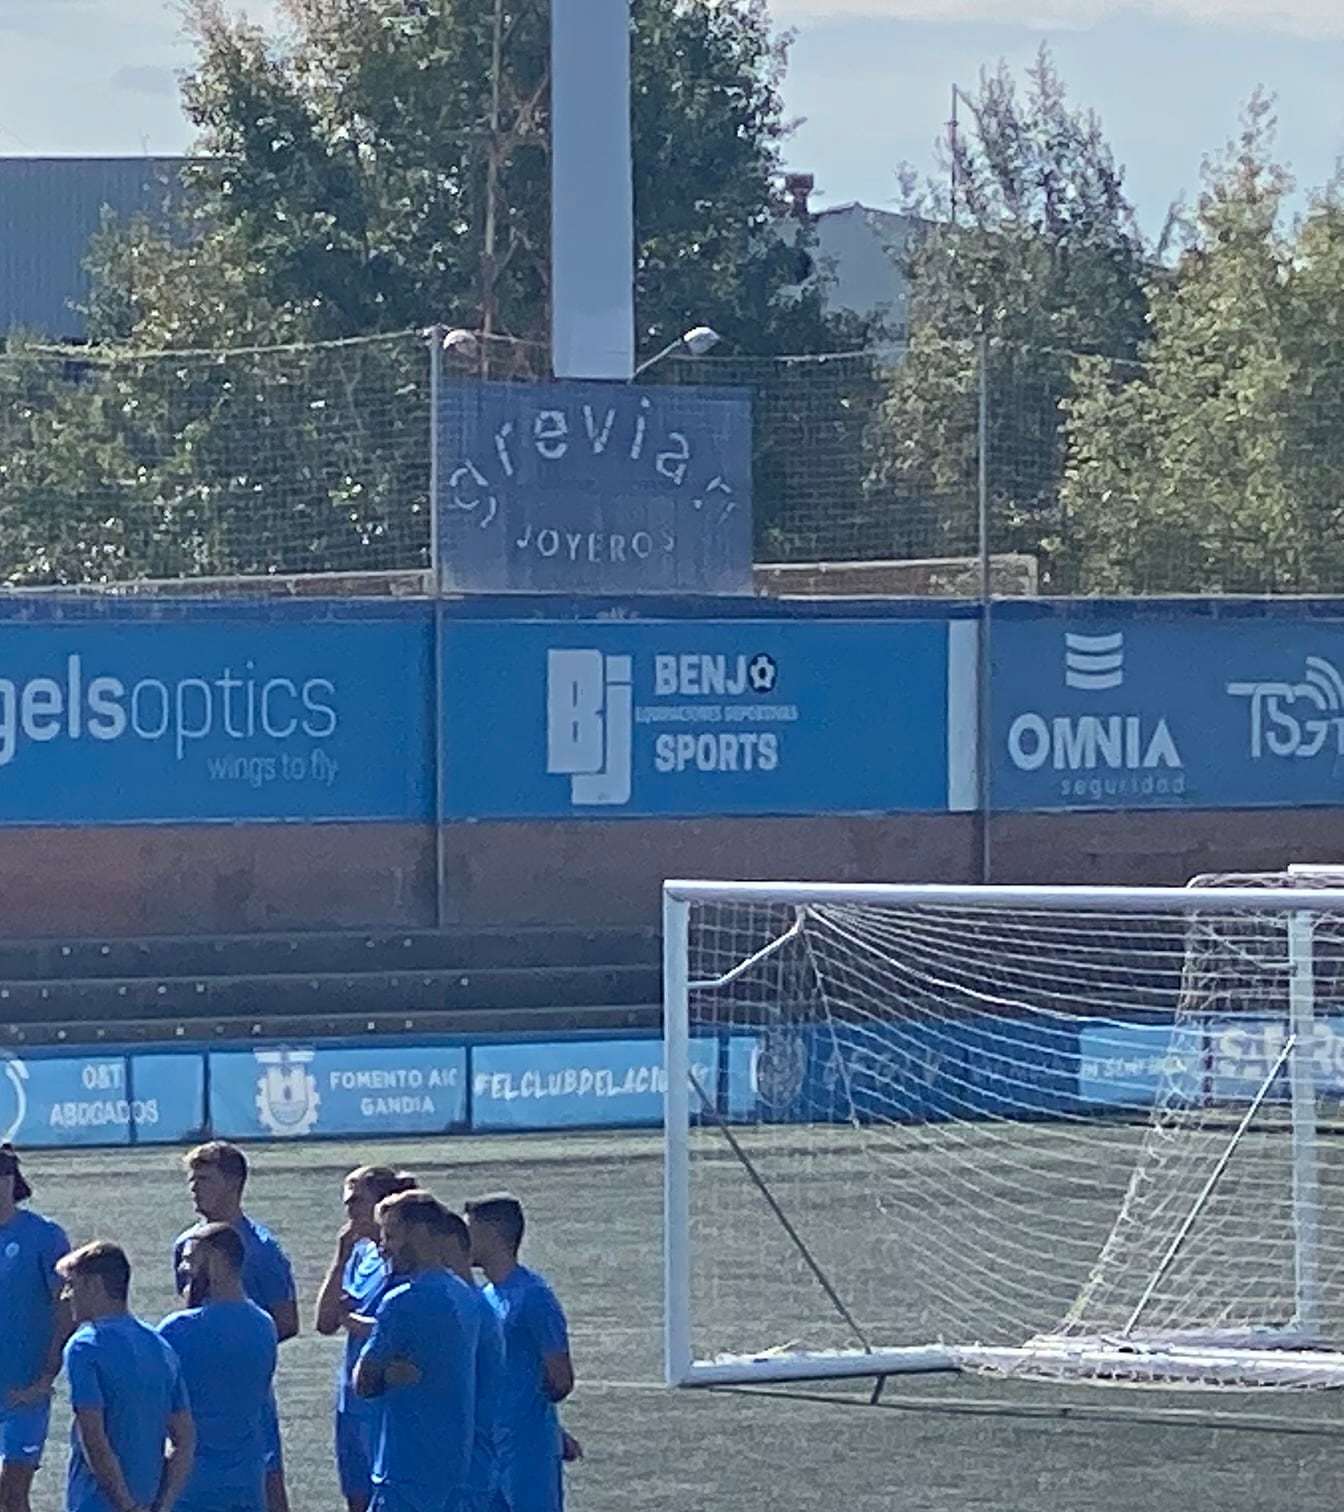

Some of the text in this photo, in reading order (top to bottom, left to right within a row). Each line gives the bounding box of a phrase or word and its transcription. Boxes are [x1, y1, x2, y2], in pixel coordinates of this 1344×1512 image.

[655, 733, 779, 772] SPORTS
[1008, 712, 1183, 771] OMNIA
[208, 748, 339, 788] wings to fly
[1061, 773, 1185, 799] seguridad
[81, 1064, 121, 1090] O&T
[330, 1069, 423, 1091] FOMENTO
[50, 1098, 159, 1127] ABOGADOS
[360, 1095, 435, 1116] GANDIA
